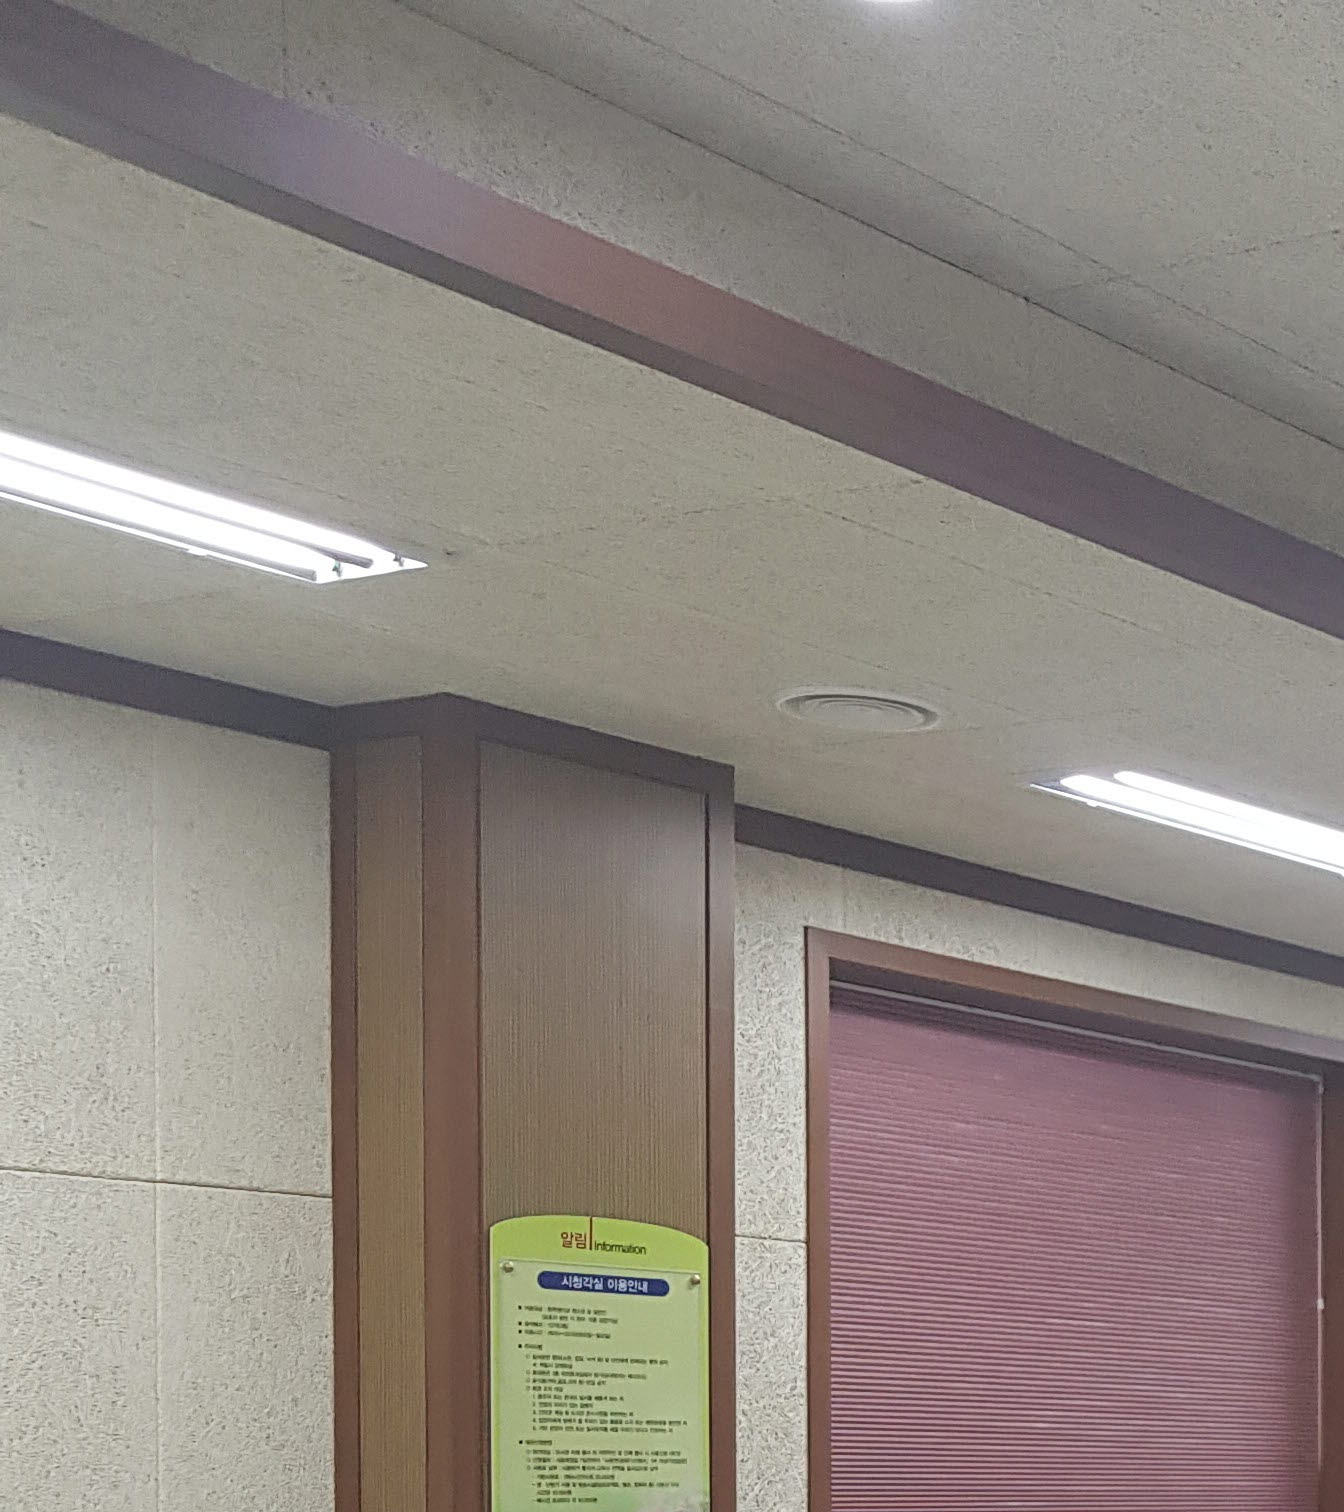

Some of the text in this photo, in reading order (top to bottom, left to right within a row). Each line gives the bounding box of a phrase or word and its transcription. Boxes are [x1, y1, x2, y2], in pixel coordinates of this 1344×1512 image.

[560, 1231, 587, 1250] 알림
[594, 1240, 647, 1256] Information
[561, 1274, 649, 1294] 시청각실 이용안내
